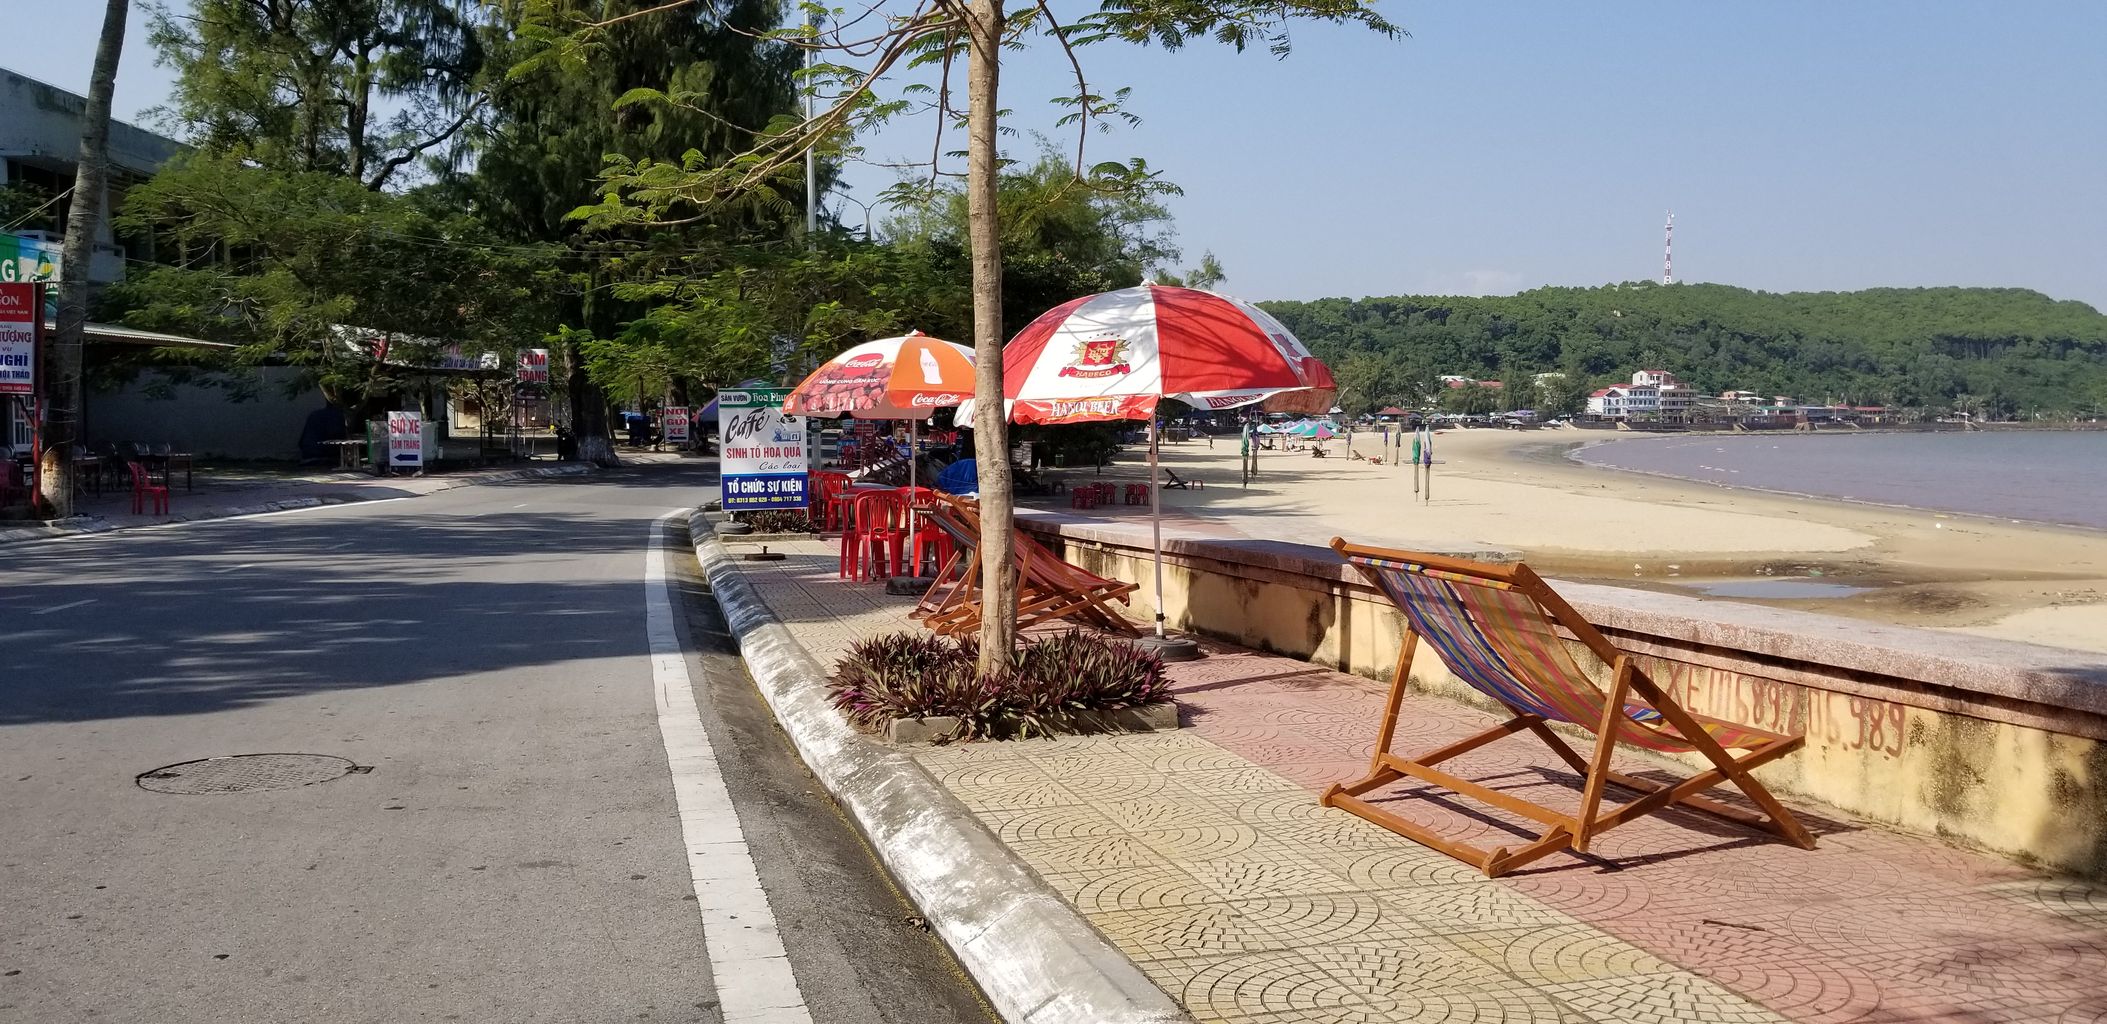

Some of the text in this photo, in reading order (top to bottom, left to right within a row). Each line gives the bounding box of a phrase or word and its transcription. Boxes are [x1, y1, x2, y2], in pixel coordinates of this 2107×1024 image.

[1075, 369, 1112, 378] HABECO
[912, 393, 960, 407] Coca-Cola
[1089, 399, 1121, 415] BEER
[409, 419, 420, 434] XE
[725, 406, 770, 444] Café
[726, 447, 748, 459] SINH
[763, 446, 781, 458] HOA
